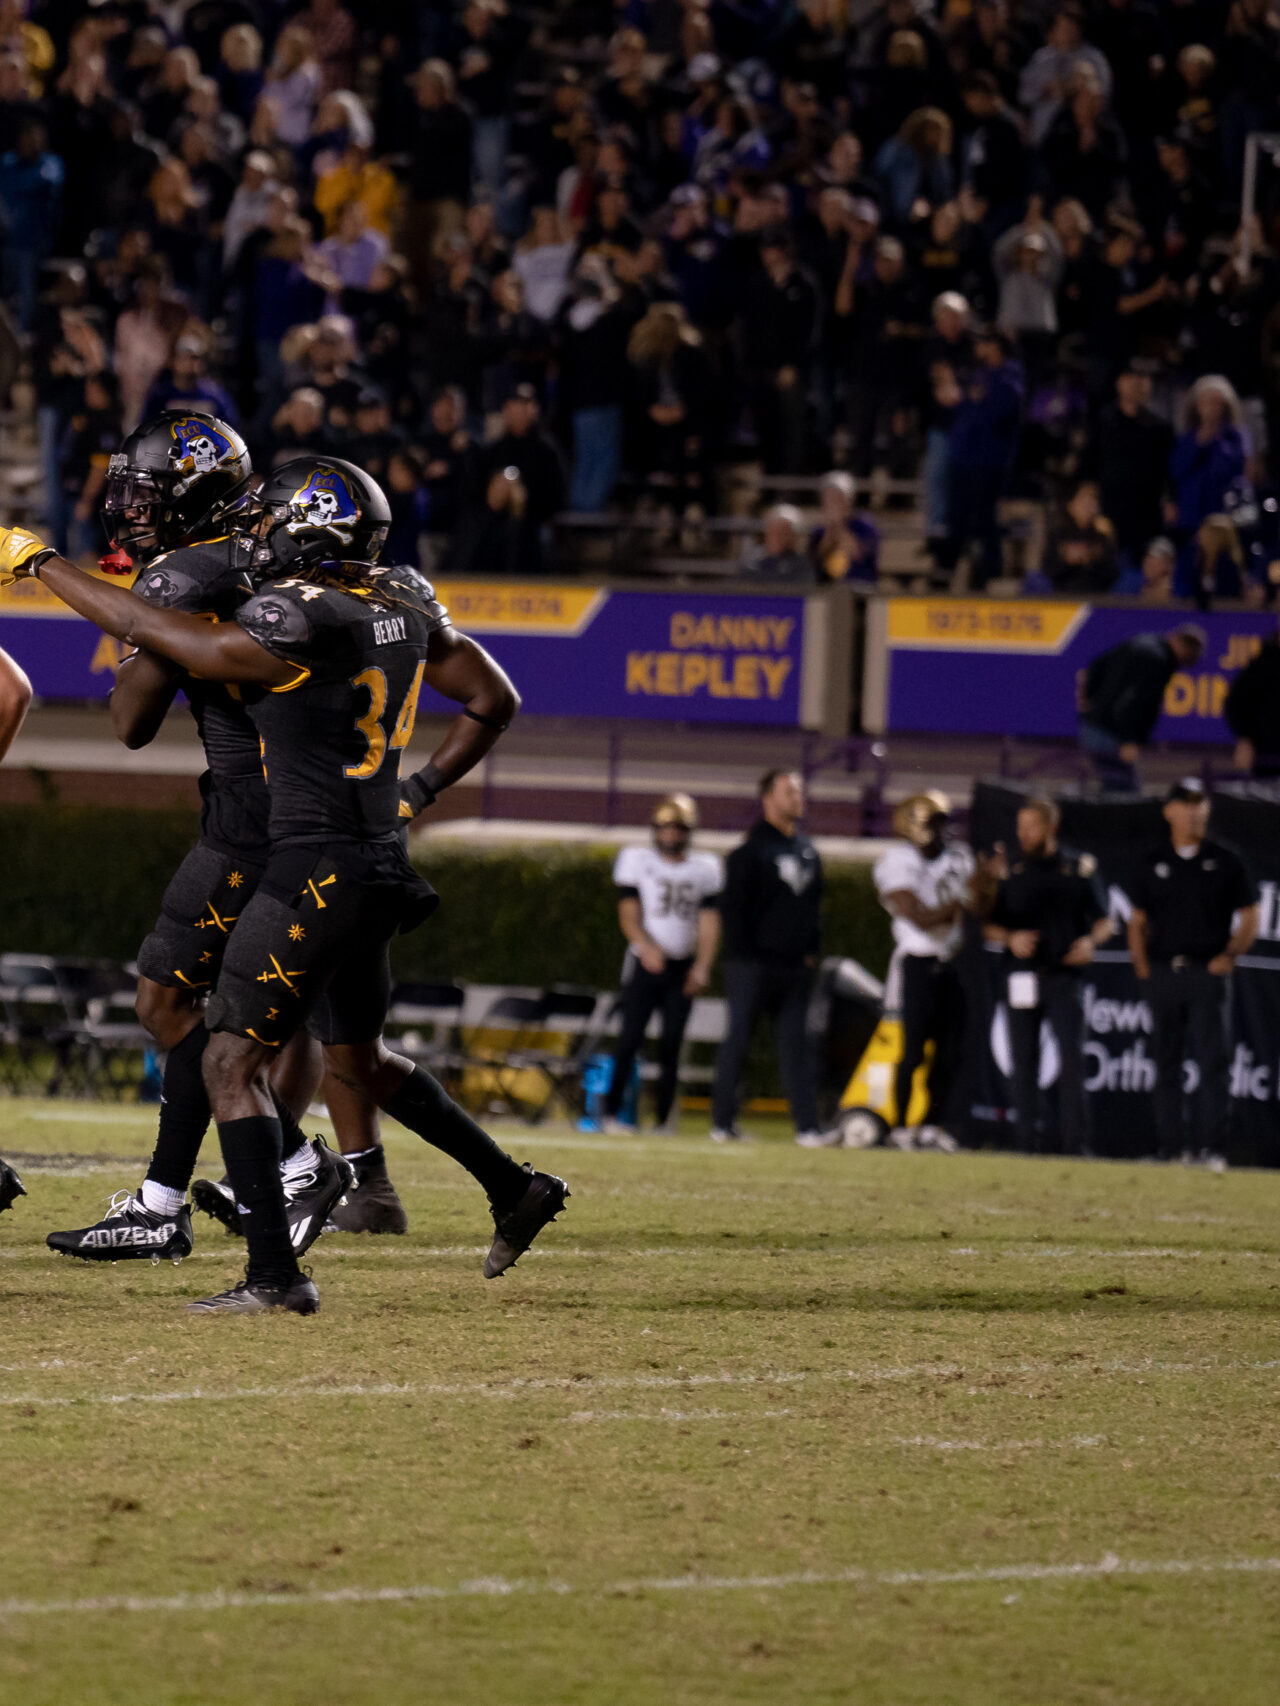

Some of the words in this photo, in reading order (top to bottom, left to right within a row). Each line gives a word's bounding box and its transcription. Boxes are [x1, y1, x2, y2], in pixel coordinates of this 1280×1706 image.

[180, 423, 201, 440] ECU
[314, 477, 338, 488] ECU
[373, 616, 407, 645] BERRY
[669, 611, 795, 651] DANNY
[625, 651, 793, 700] KEPLEY
[342, 660, 426, 779] 34
